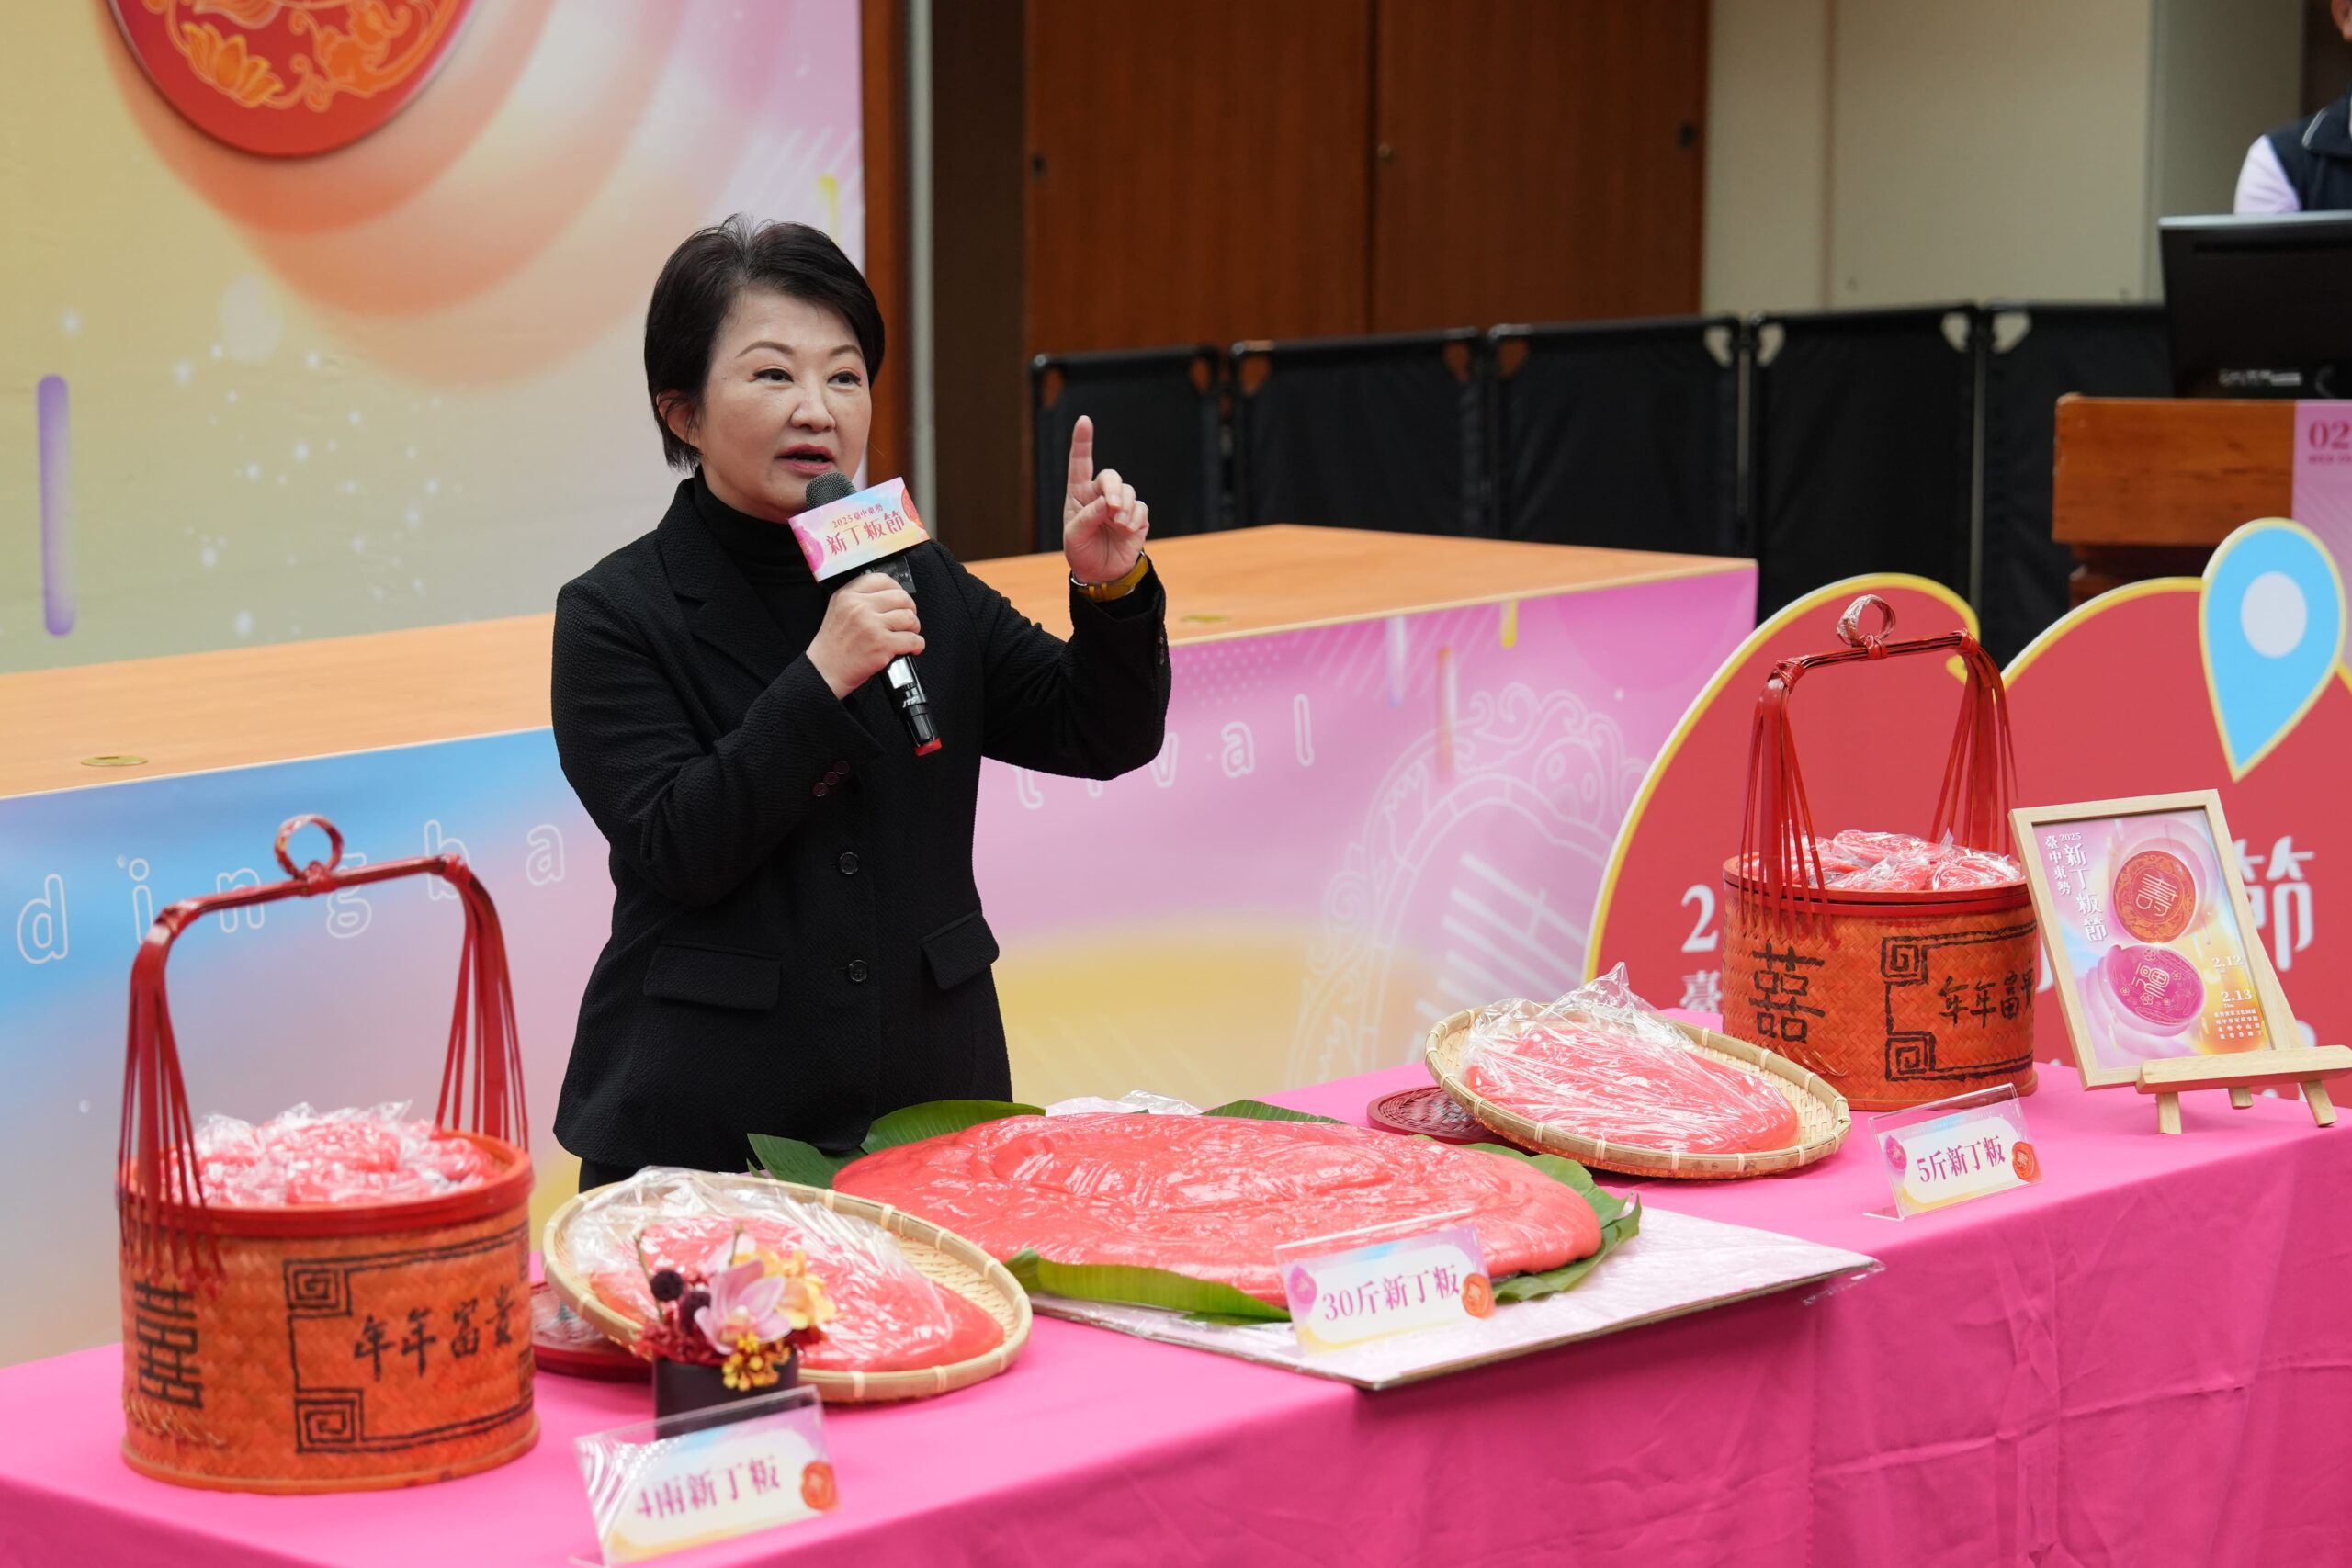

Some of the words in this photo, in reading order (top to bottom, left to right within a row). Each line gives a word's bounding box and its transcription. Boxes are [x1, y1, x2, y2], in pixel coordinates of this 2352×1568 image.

[826, 510, 905, 556] 新丁粄節
[2058, 832, 2083, 842] 2025
[2045, 834, 2072, 896] 臺中東勢
[2064, 843, 2109, 942] 新丁粄節
[2211, 955, 2244, 968] 2.12
[2221, 988, 2253, 1002] 2.13
[1916, 1134, 2006, 1183] 5斤新丁粄
[1322, 1264, 1461, 1321] 30斤新丁粄
